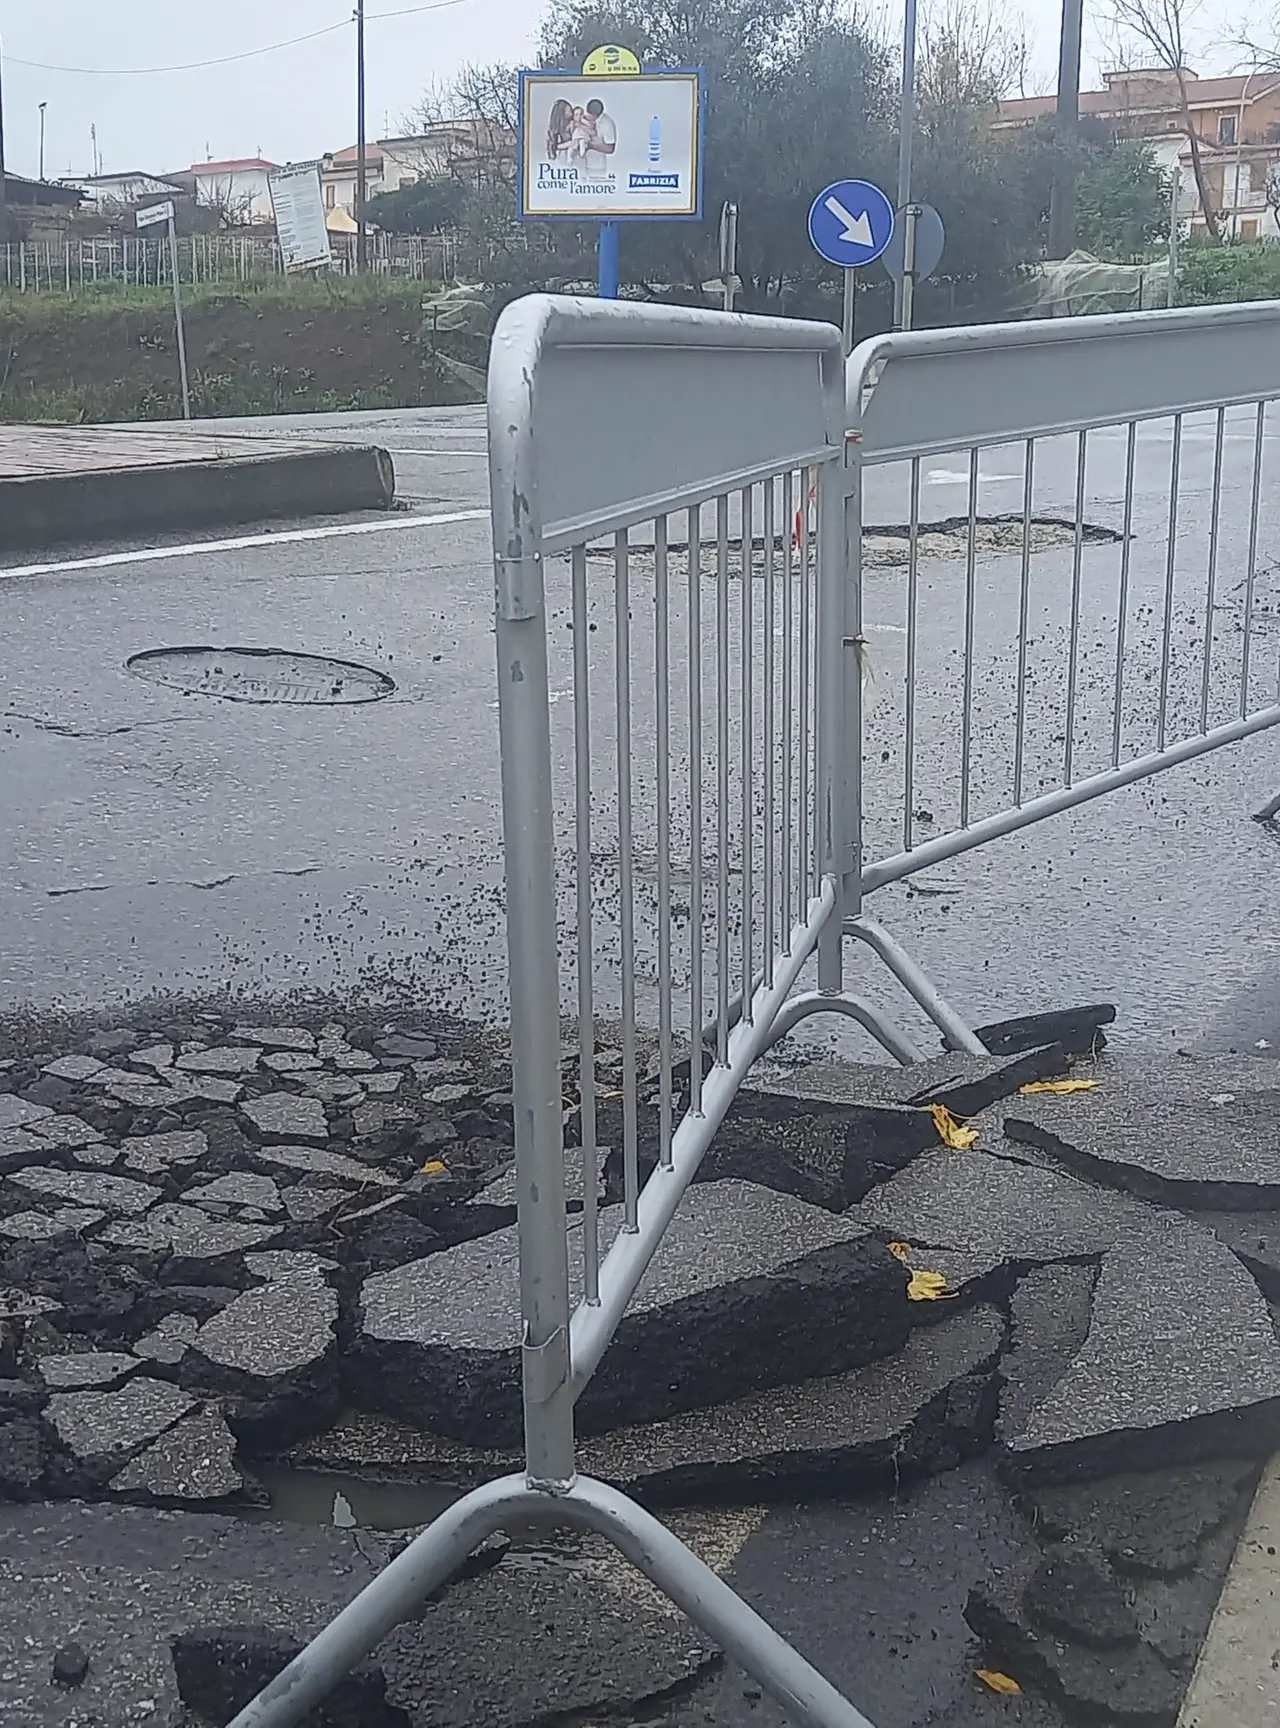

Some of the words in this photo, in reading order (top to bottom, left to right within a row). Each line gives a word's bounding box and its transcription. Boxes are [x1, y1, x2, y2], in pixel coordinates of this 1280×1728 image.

[538, 163, 578, 180] Pura
[537, 180, 568, 190] come
[570, 182, 616, 194] l'amore
[631, 175, 677, 187] FABRIZIA
